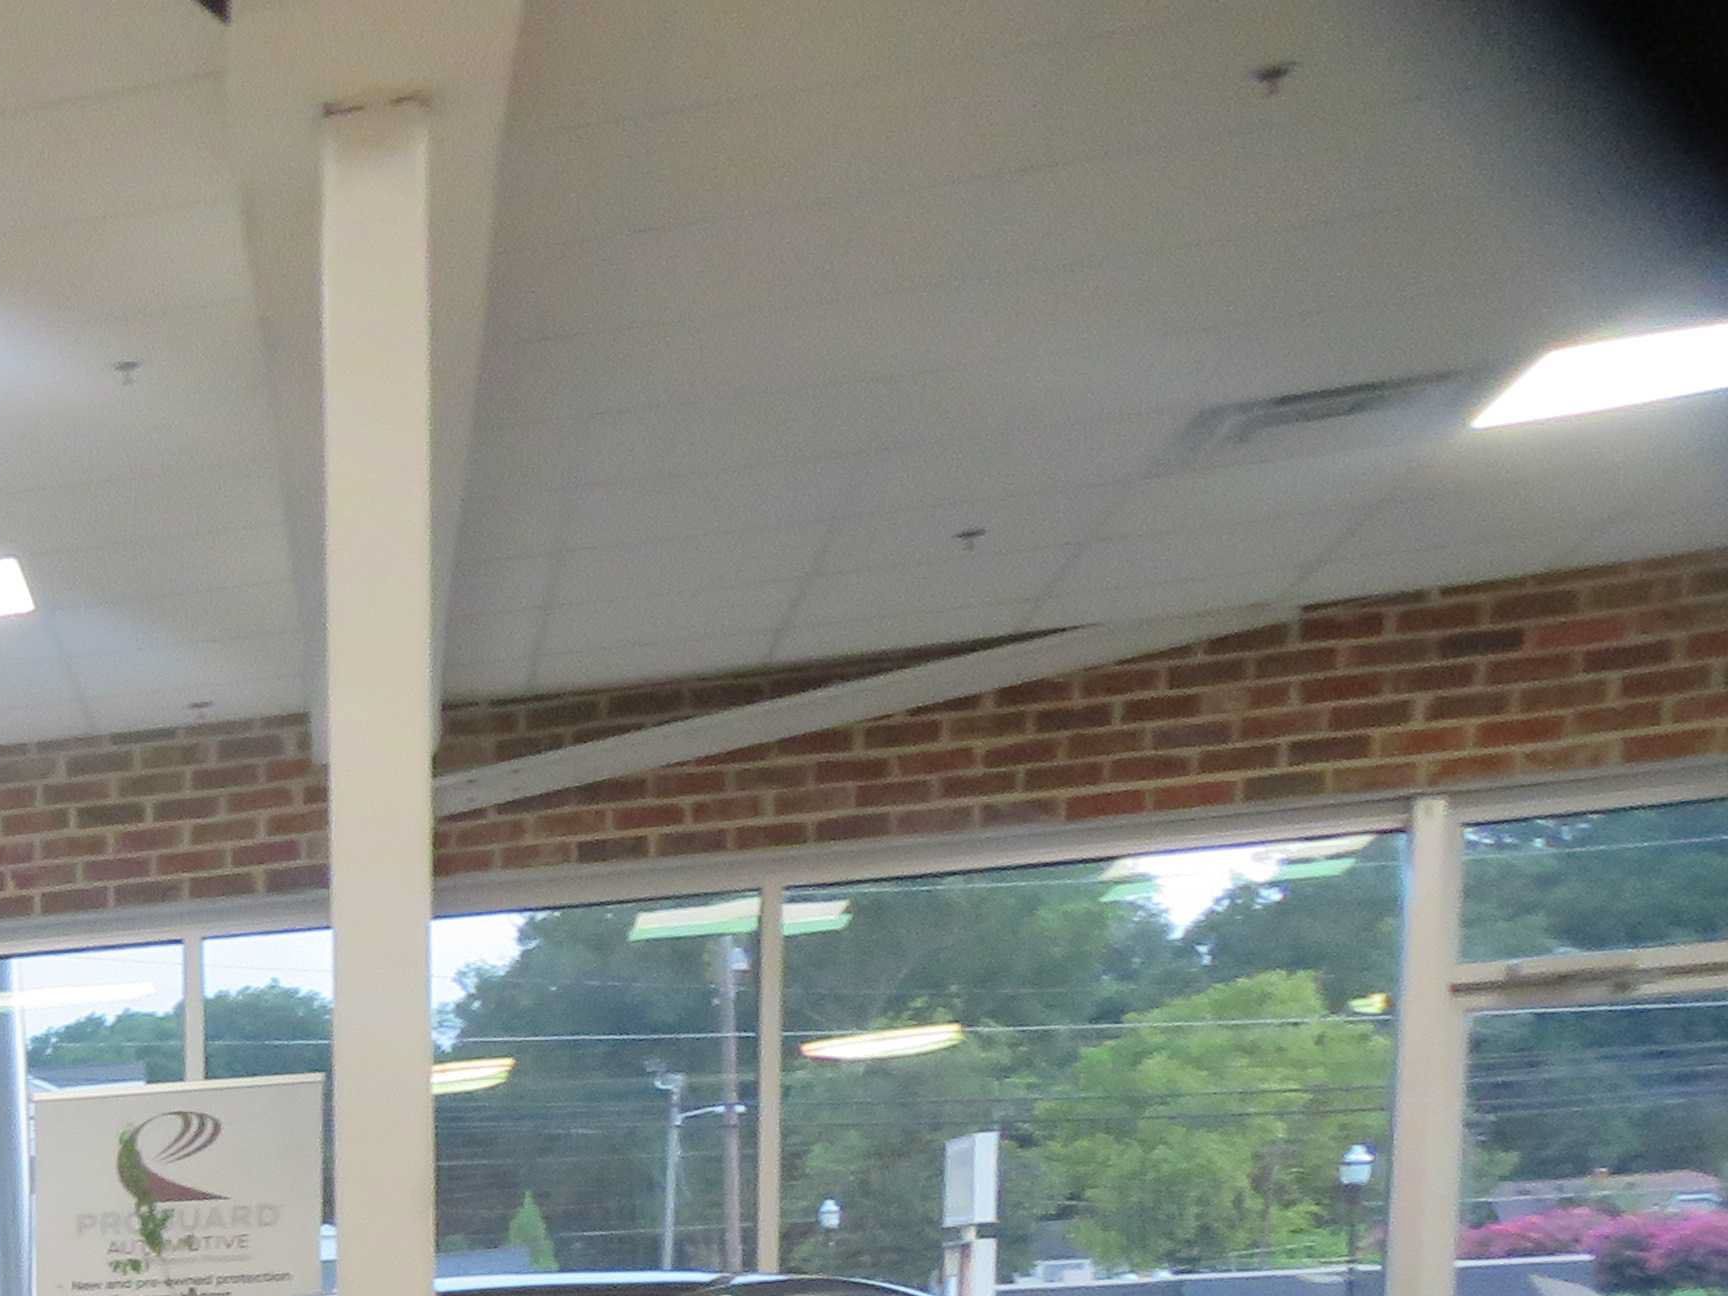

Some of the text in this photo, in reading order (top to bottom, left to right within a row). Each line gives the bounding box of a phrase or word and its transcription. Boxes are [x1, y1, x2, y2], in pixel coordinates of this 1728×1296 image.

[76, 1203, 281, 1236] PROUARD
[107, 1233, 249, 1254] AUTMOTIVE
[72, 1280, 101, 1290] New
[106, 1279, 132, 1289] and
[216, 1272, 291, 1286] protection
